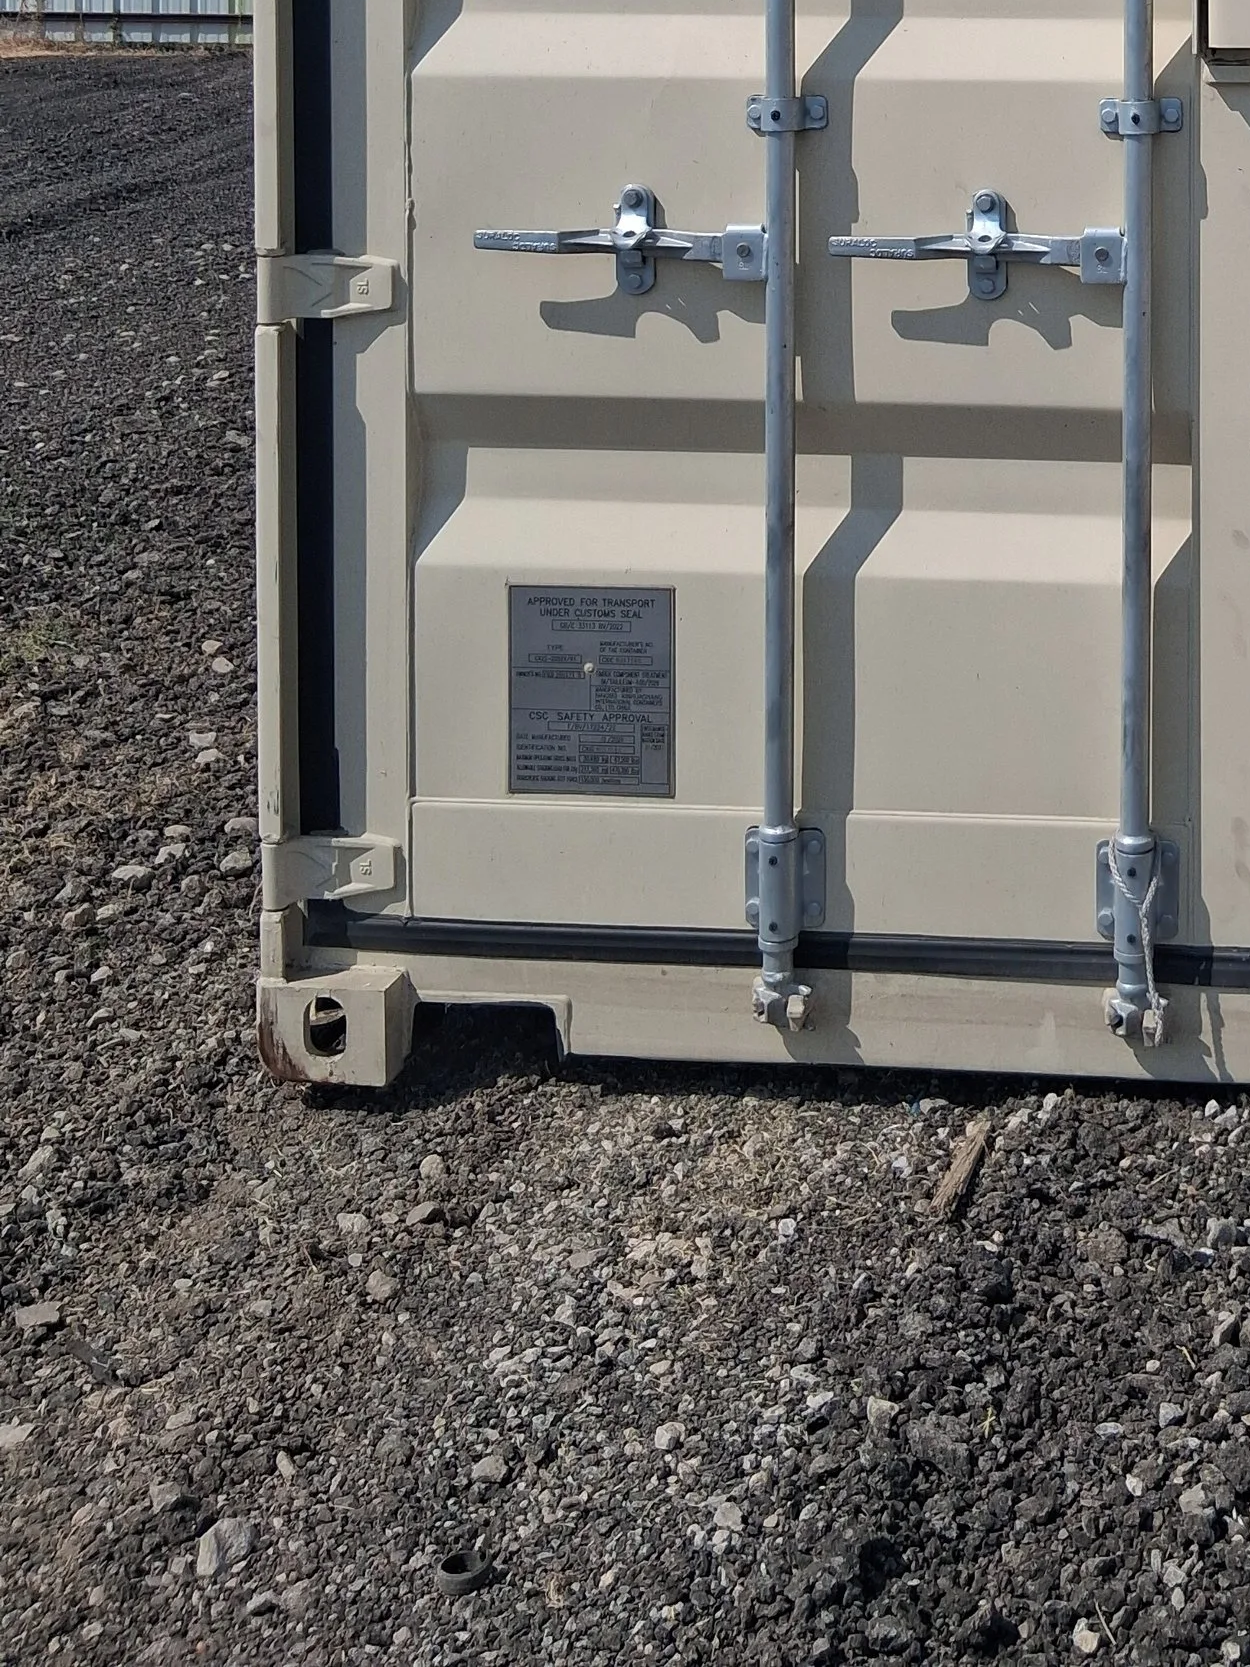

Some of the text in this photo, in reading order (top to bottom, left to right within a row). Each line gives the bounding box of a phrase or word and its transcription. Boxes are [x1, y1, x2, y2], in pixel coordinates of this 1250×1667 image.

[527, 596, 656, 609] APPROVED FOR TRANSPORT
[539, 608, 643, 619] UNDER CUSTOMS SEAL
[547, 644, 564, 652] TYPE
[528, 711, 653, 724] CSC SAFETY APPROVAL
